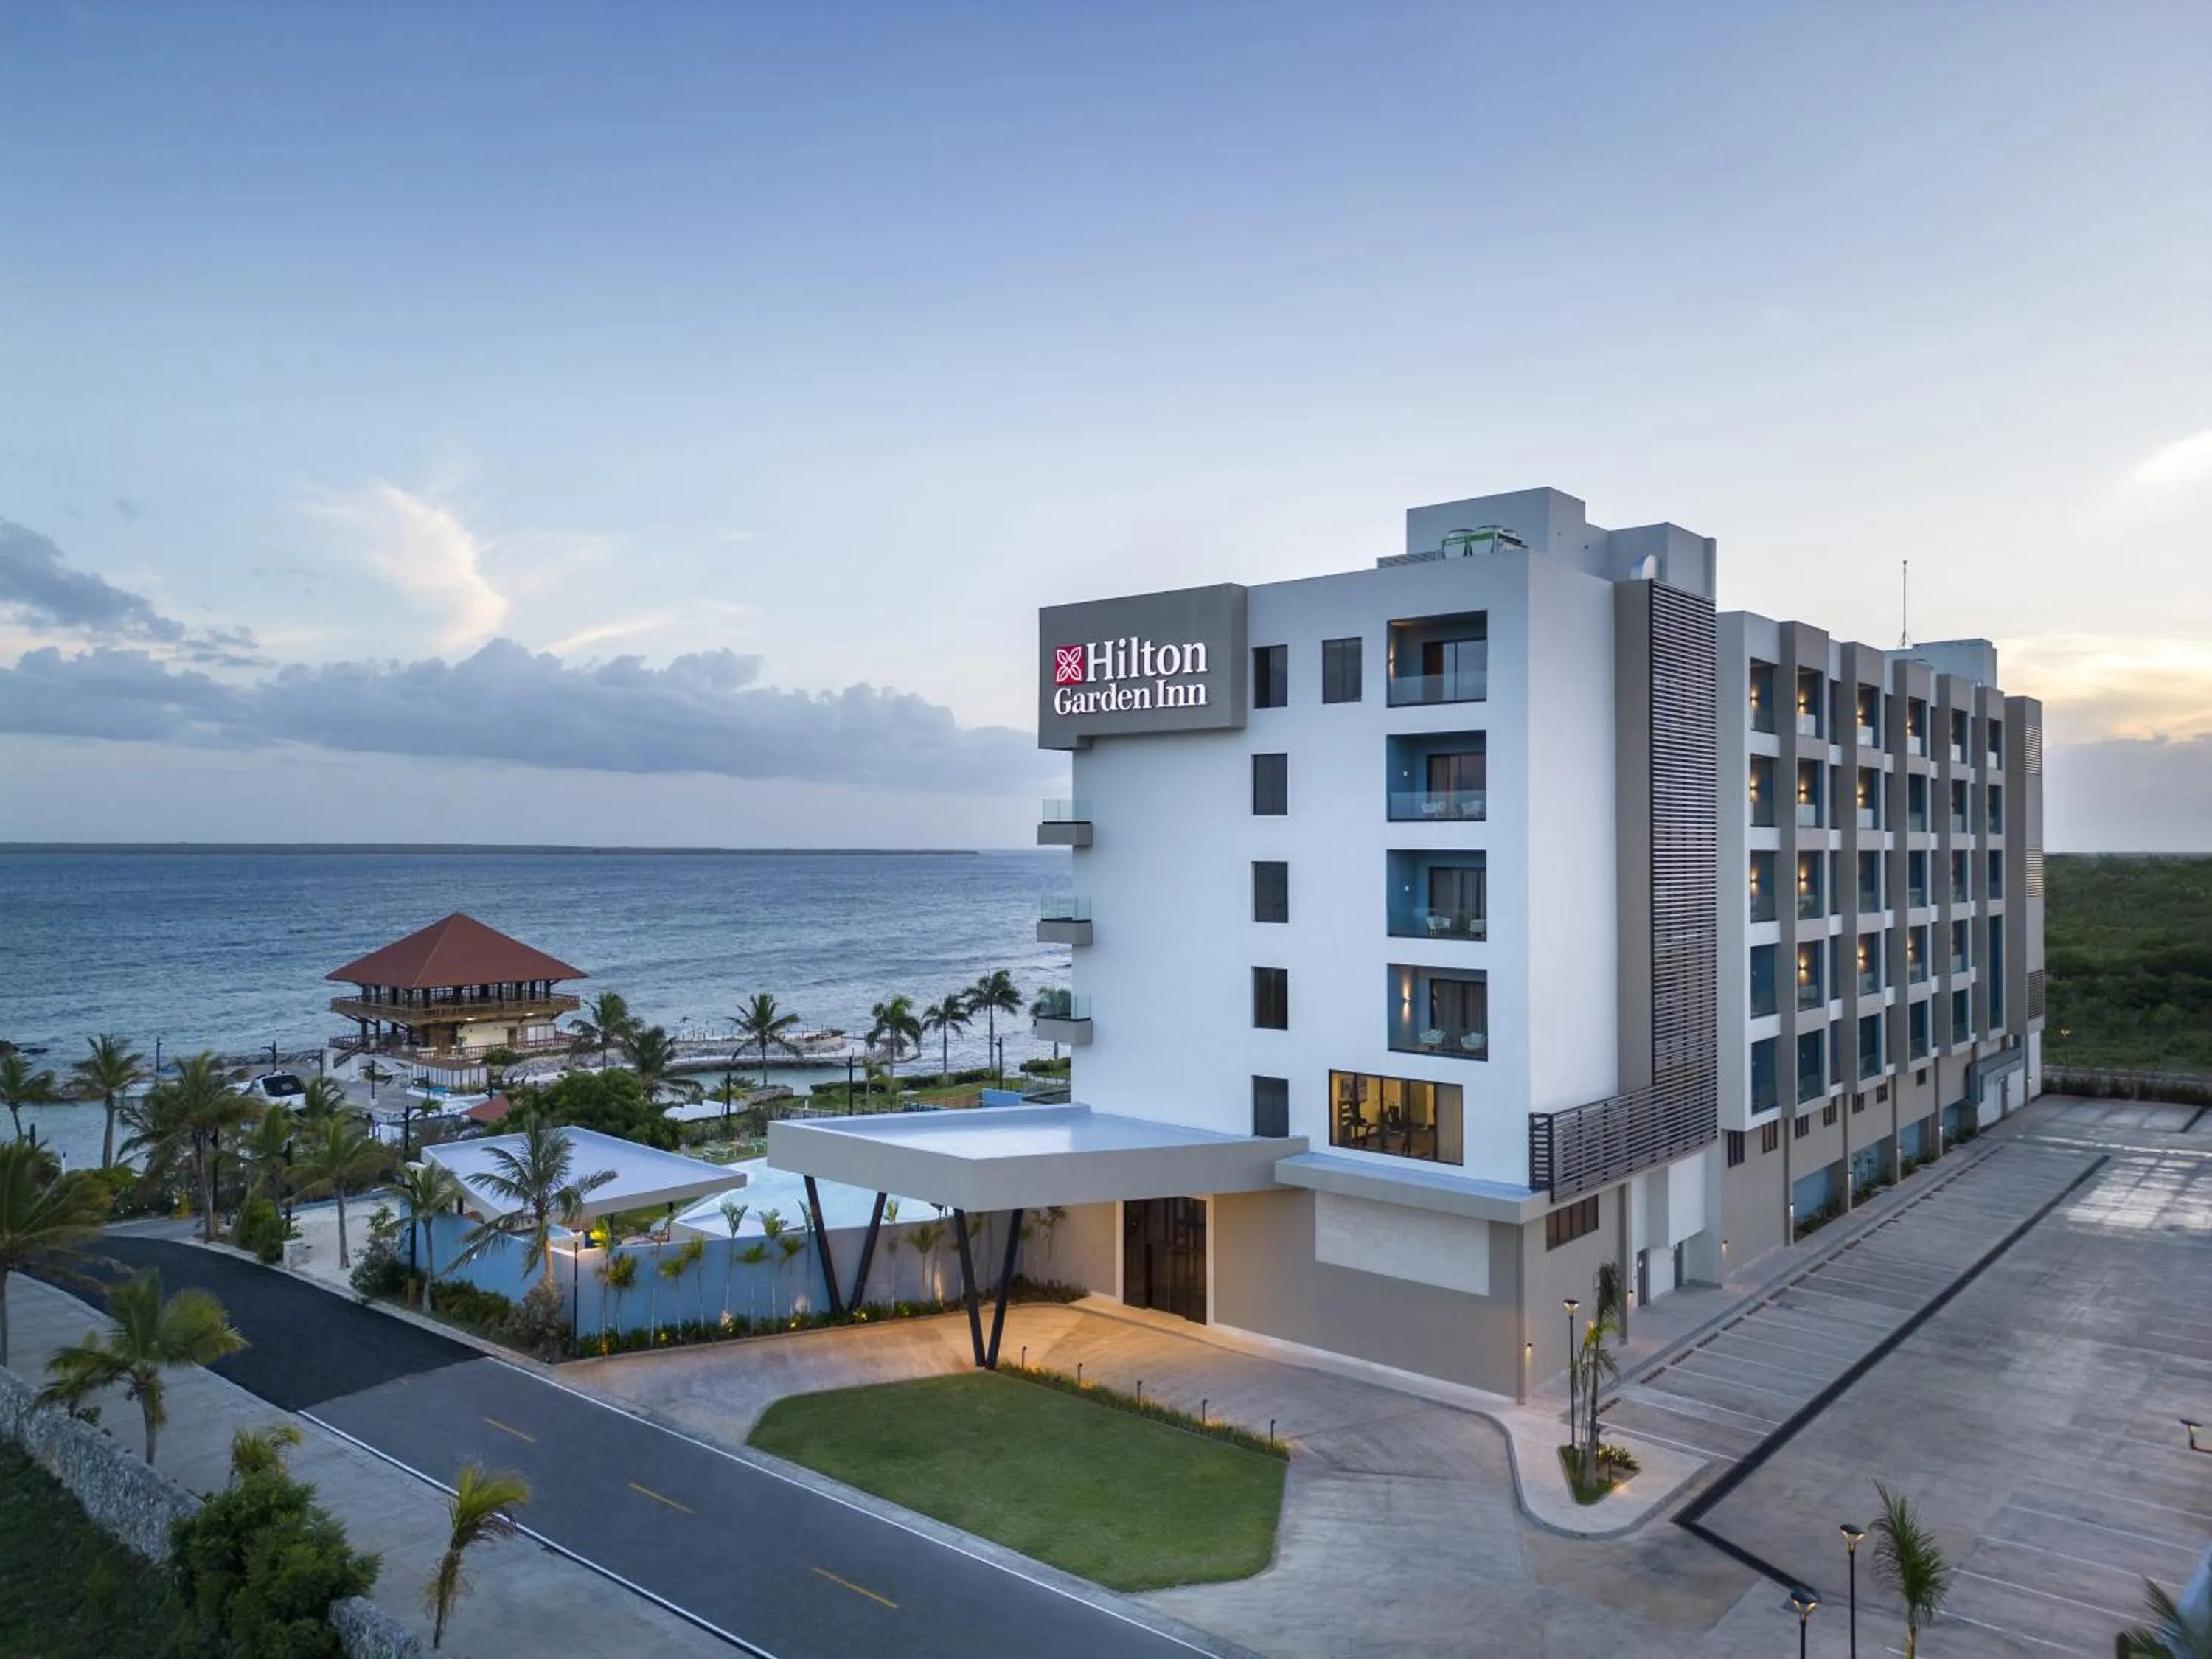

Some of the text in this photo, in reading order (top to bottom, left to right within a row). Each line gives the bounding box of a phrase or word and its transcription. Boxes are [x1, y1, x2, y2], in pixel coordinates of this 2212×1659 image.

[1086, 636, 1208, 682] Hilton
[1054, 679, 1208, 715] Garden Inn
